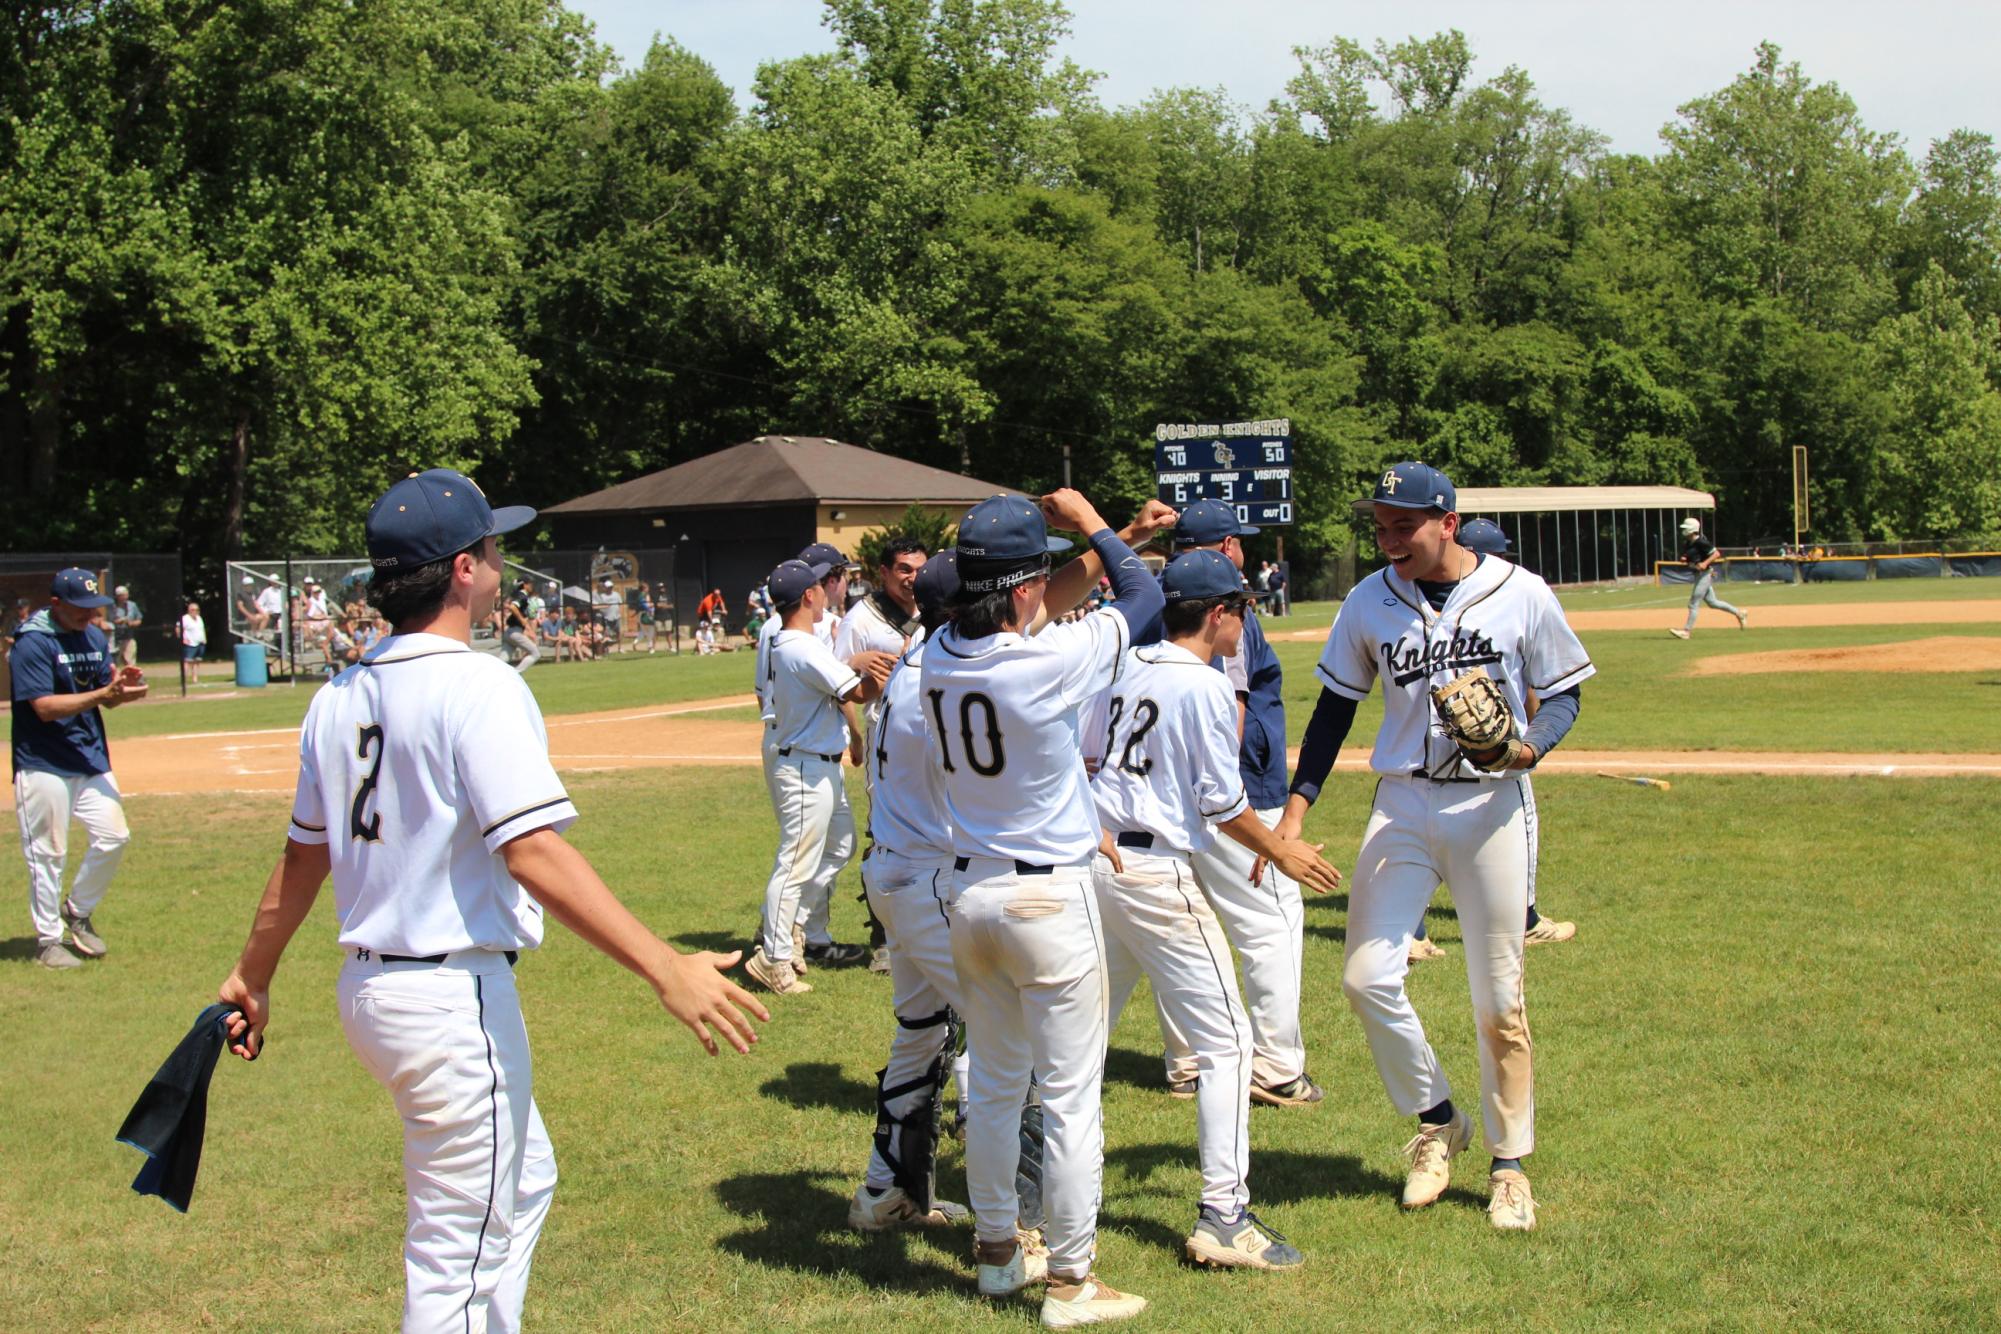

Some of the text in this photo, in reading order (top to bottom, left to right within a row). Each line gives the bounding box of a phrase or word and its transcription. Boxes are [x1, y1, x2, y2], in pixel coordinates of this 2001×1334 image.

[1156, 418, 1290, 441] GOLDEN KNIGHTS
[1265, 447, 1285, 462] 50
[1159, 472, 1200, 485] KNIGHTS
[1210, 472, 1240, 483] INNING
[1254, 469, 1290, 481] VISITOR
[1175, 483, 1187, 503] 6
[1196, 485, 1204, 495] H
[1221, 481, 1233, 501] 3
[1247, 482, 1254, 492] E
[1282, 480, 1287, 498] 1
[1262, 508, 1279, 518] OUT
[1280, 503, 1292, 522] 0
[966, 579, 994, 592] NIKE
[1381, 626, 1504, 677] Knights
[927, 687, 1005, 778] 10
[351, 721, 385, 845] 2
